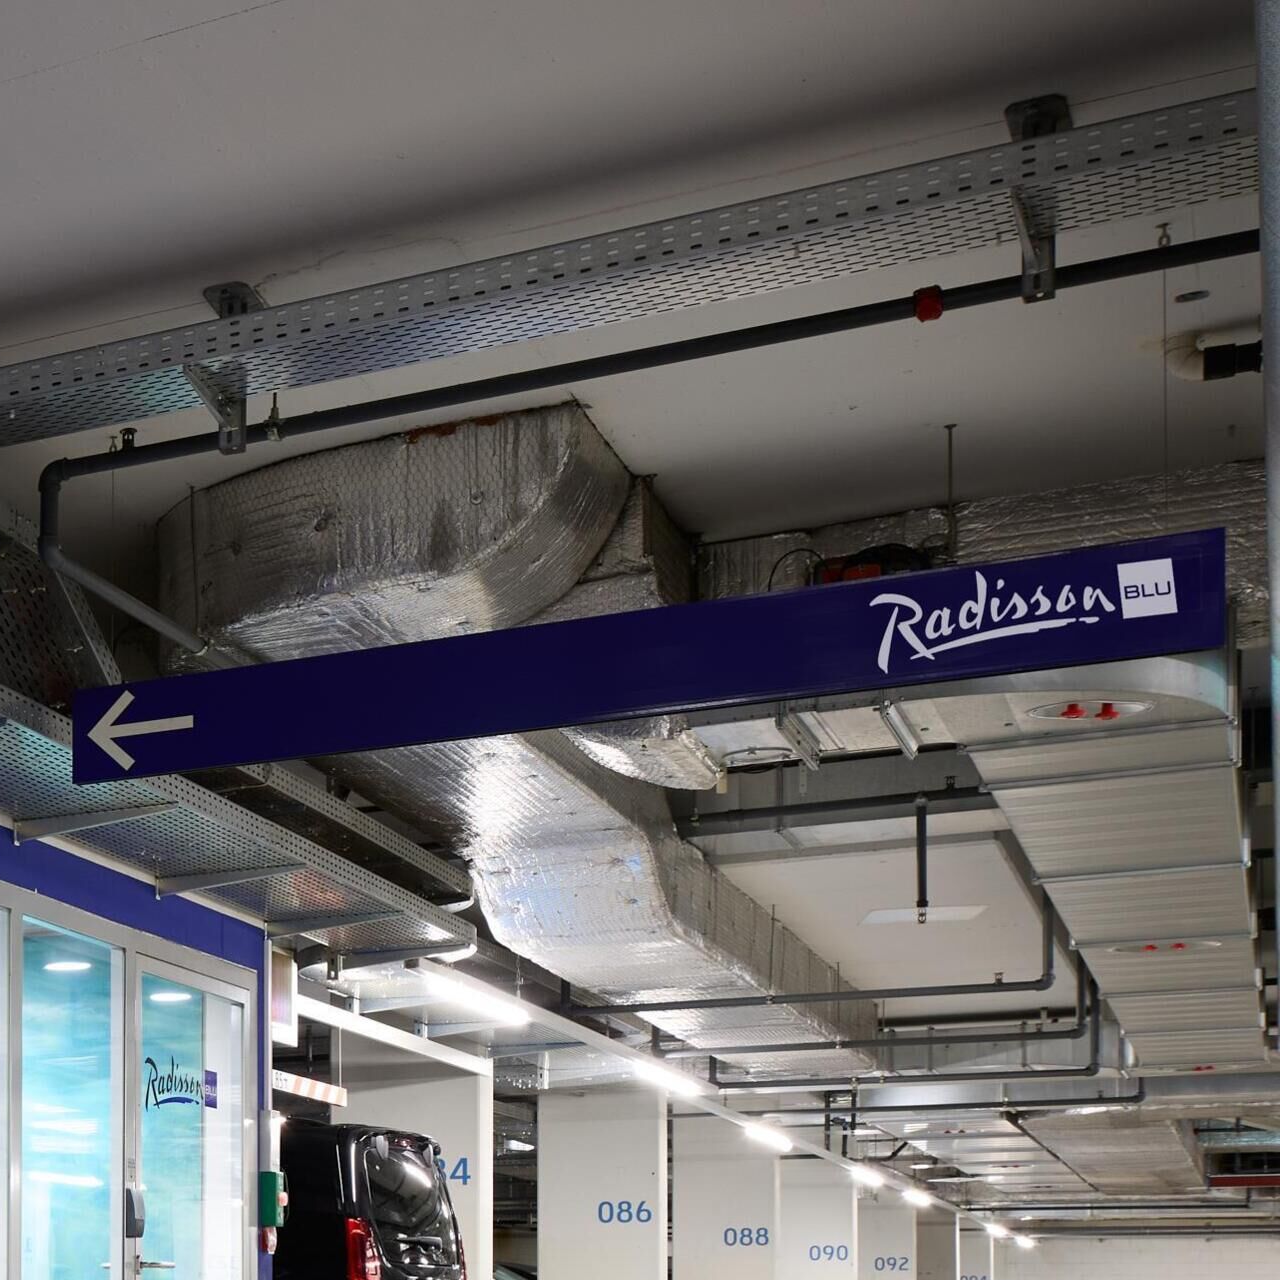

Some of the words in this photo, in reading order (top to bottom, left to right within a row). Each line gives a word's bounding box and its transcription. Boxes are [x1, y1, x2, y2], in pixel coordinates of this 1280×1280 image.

[869, 571, 1115, 675] Radisson
[1123, 580, 1172, 599] BLU
[145, 1056, 203, 1112] Radisson
[598, 1200, 653, 1224] 086
[723, 1227, 769, 1247] 088
[808, 1245, 849, 1262] 090
[874, 1256, 909, 1272] 092
